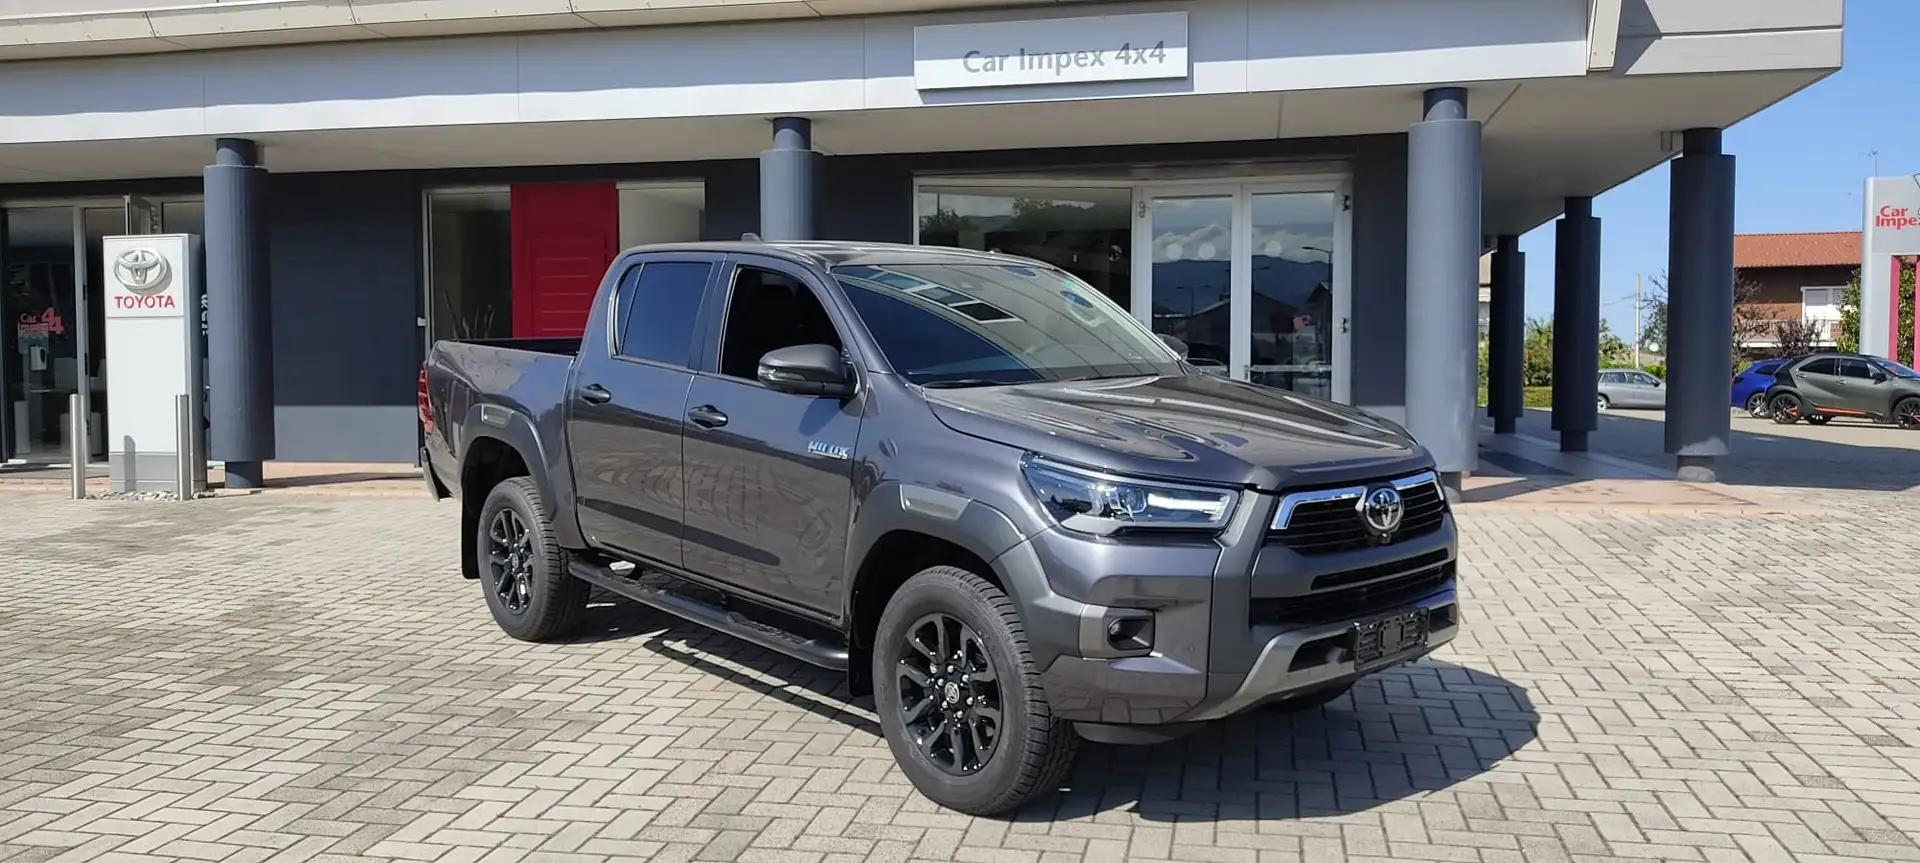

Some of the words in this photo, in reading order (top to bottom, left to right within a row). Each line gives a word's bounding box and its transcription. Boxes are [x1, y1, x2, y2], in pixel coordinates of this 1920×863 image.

[963, 50, 1009, 73] Car
[1020, 48, 1104, 76] Impex
[1115, 40, 1166, 66] 4x4
[1880, 205, 1908, 217] Car
[114, 295, 175, 309] TOYOTA
[20, 313, 38, 323] Car
[807, 440, 850, 460] HILUX
